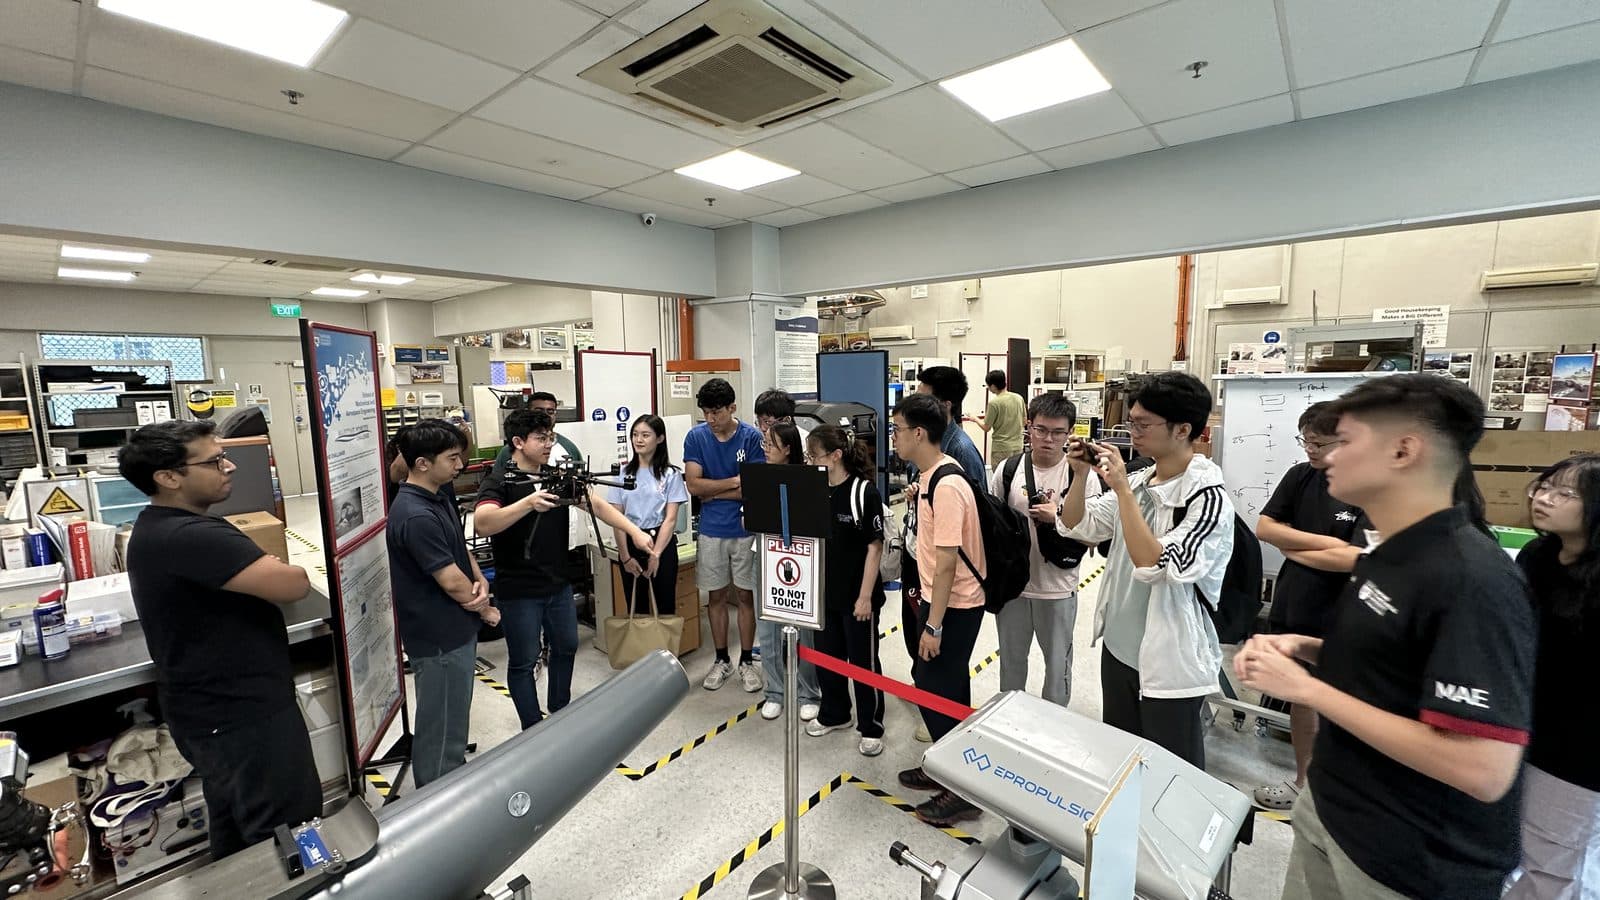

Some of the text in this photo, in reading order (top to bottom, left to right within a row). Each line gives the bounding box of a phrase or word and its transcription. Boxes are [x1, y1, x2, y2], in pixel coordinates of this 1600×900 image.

[277, 305, 297, 315] EXIT
[1299, 382, 1329, 392] Front
[768, 540, 811, 555] PLEASE
[771, 587, 806, 600] DO NOT
[772, 596, 804, 609] TOUCH
[1434, 681, 1490, 709] MAE
